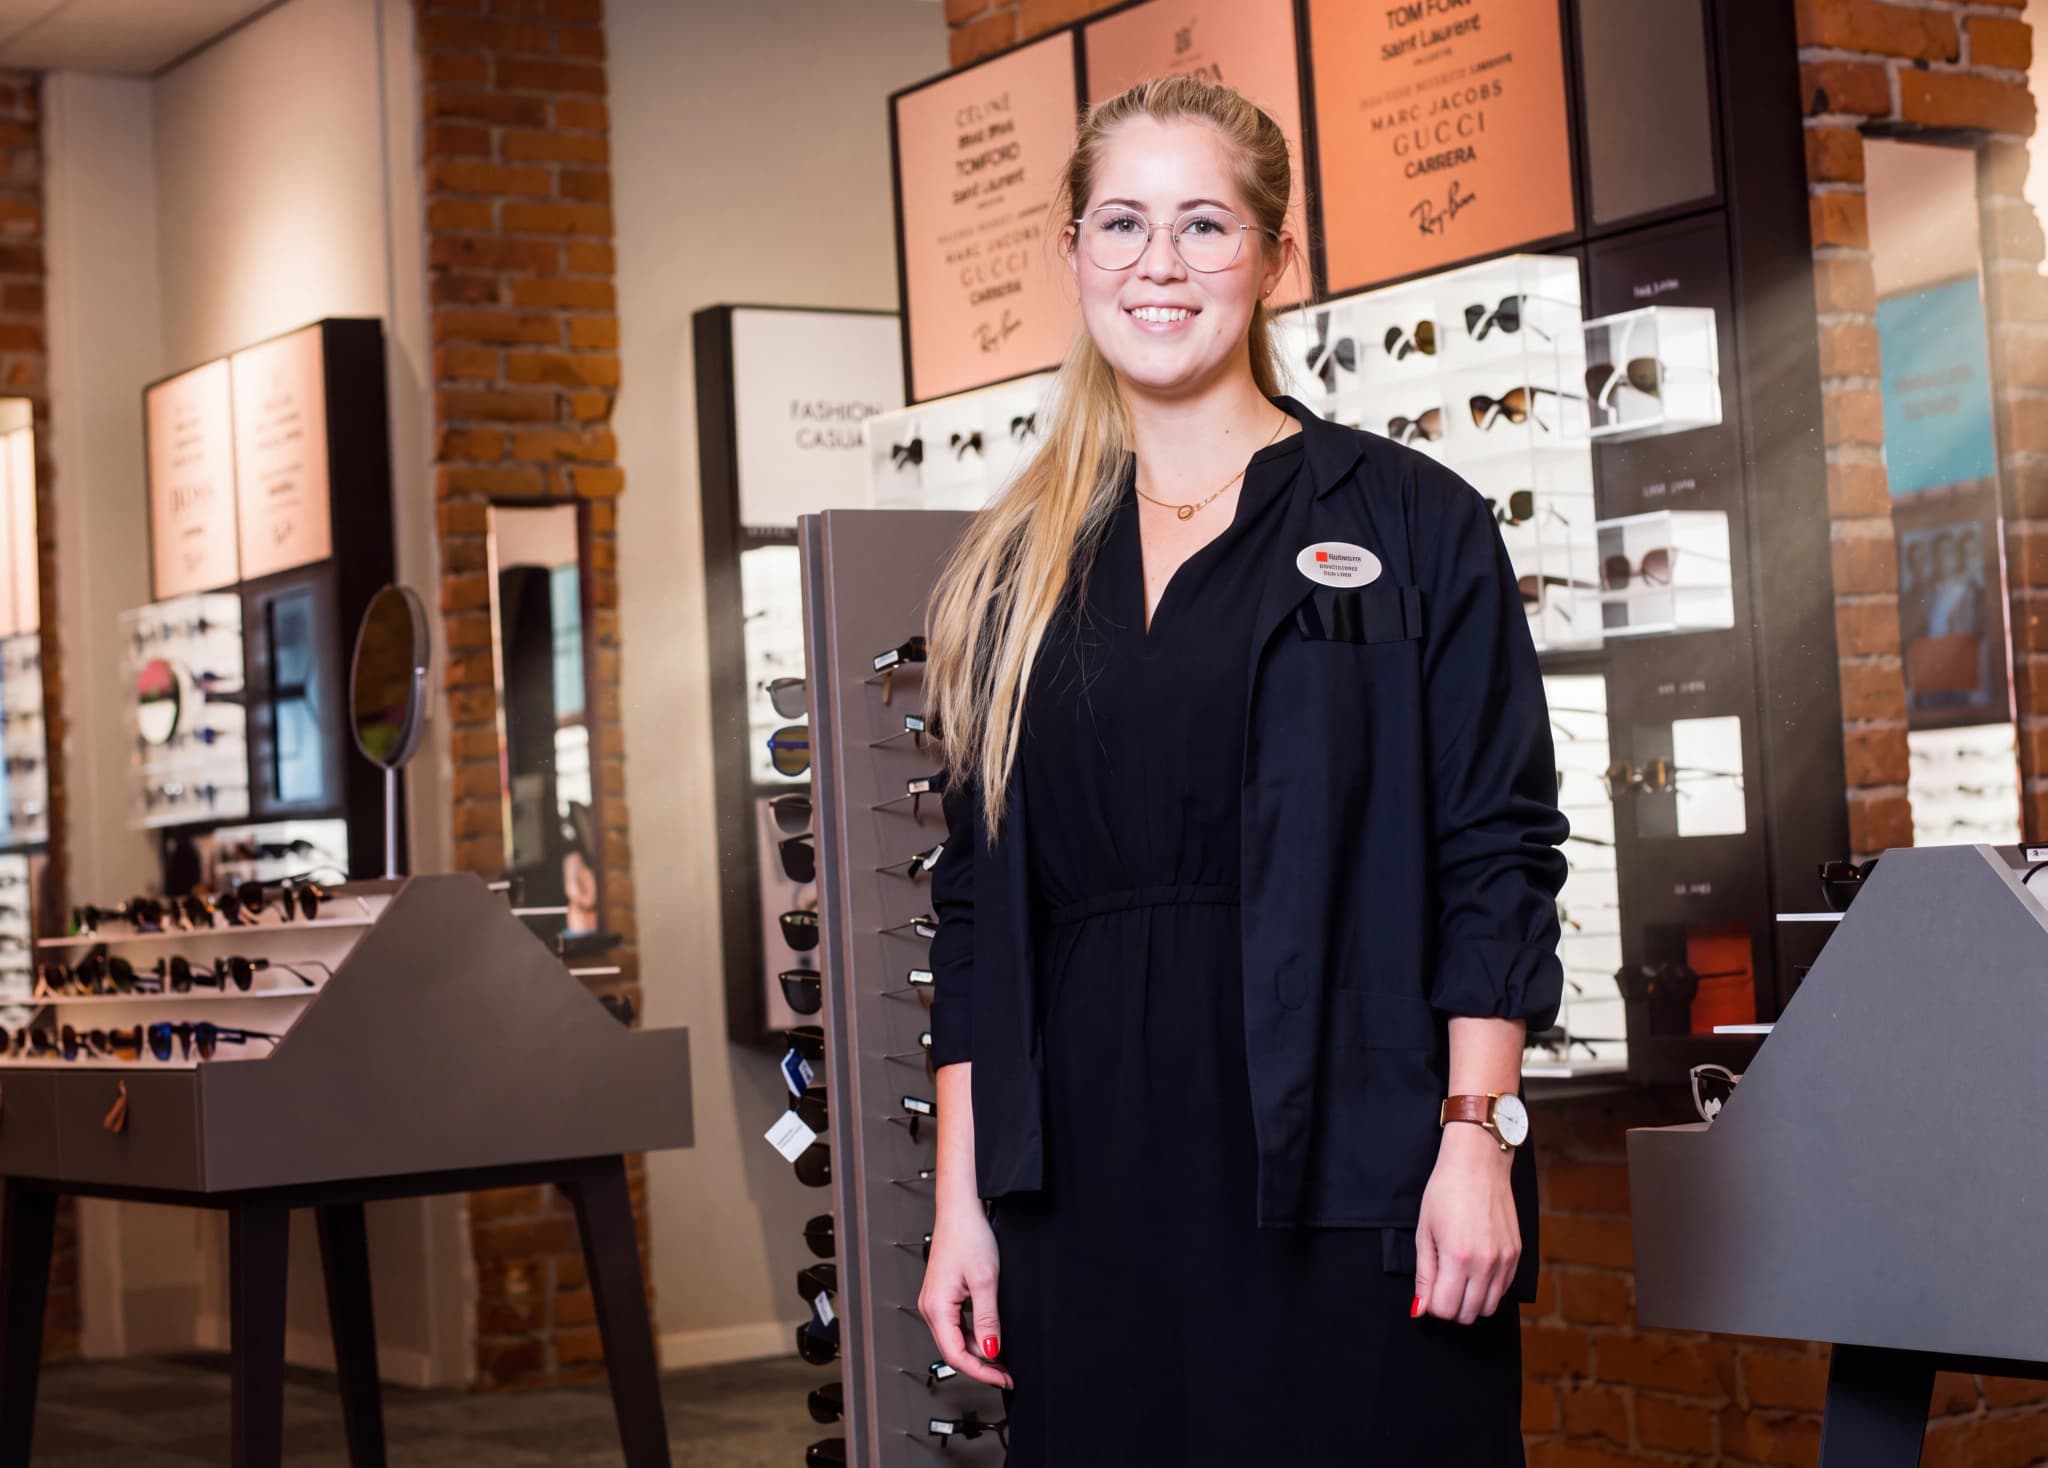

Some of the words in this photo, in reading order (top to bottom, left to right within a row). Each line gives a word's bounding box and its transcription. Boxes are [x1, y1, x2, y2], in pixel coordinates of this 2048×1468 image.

[1385, 2, 1422, 30] TOM
[1381, 34, 1417, 61] Saint
[1421, 13, 1481, 47] Laurent
[1371, 104, 1420, 131] MARC
[1429, 79, 1503, 117] JACOBS
[1393, 112, 1485, 156] GUCCI
[1405, 145, 1477, 179] CARRERA
[796, 428, 864, 449] CASUA
